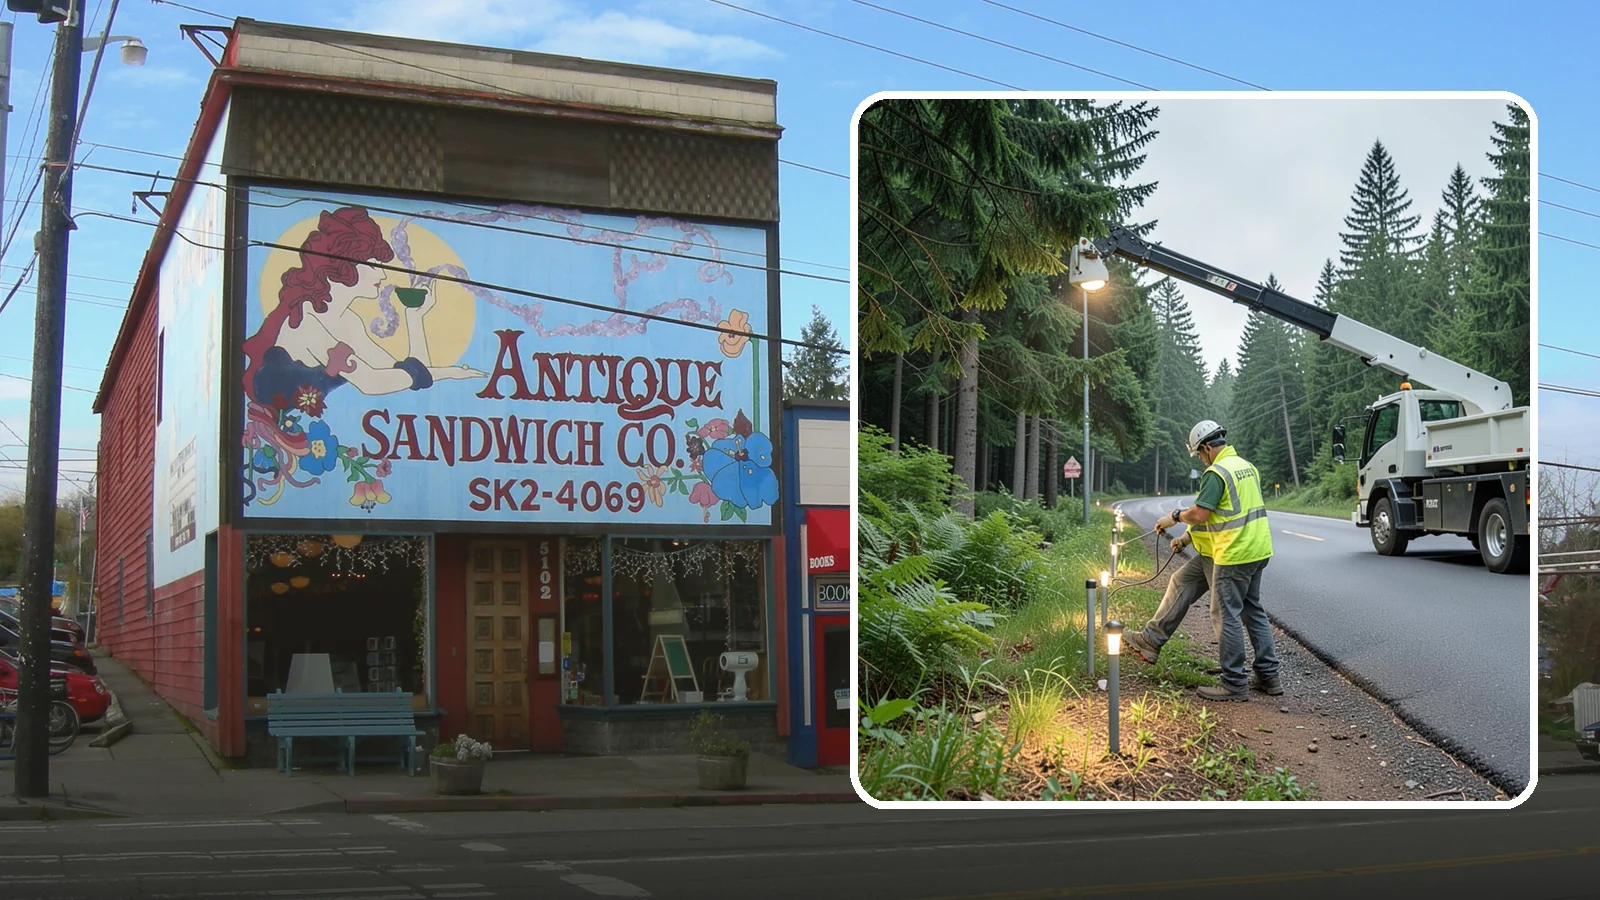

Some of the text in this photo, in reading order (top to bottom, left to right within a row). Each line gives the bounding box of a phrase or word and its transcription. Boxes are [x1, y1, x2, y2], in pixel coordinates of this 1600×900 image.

[476, 329, 723, 421] ANTIQUE
[361, 408, 685, 469] SANDWICH CO.
[468, 476, 646, 514] SK2-4069
[540, 541, 551, 600] 5102
[809, 555, 835, 569] BOOKS
